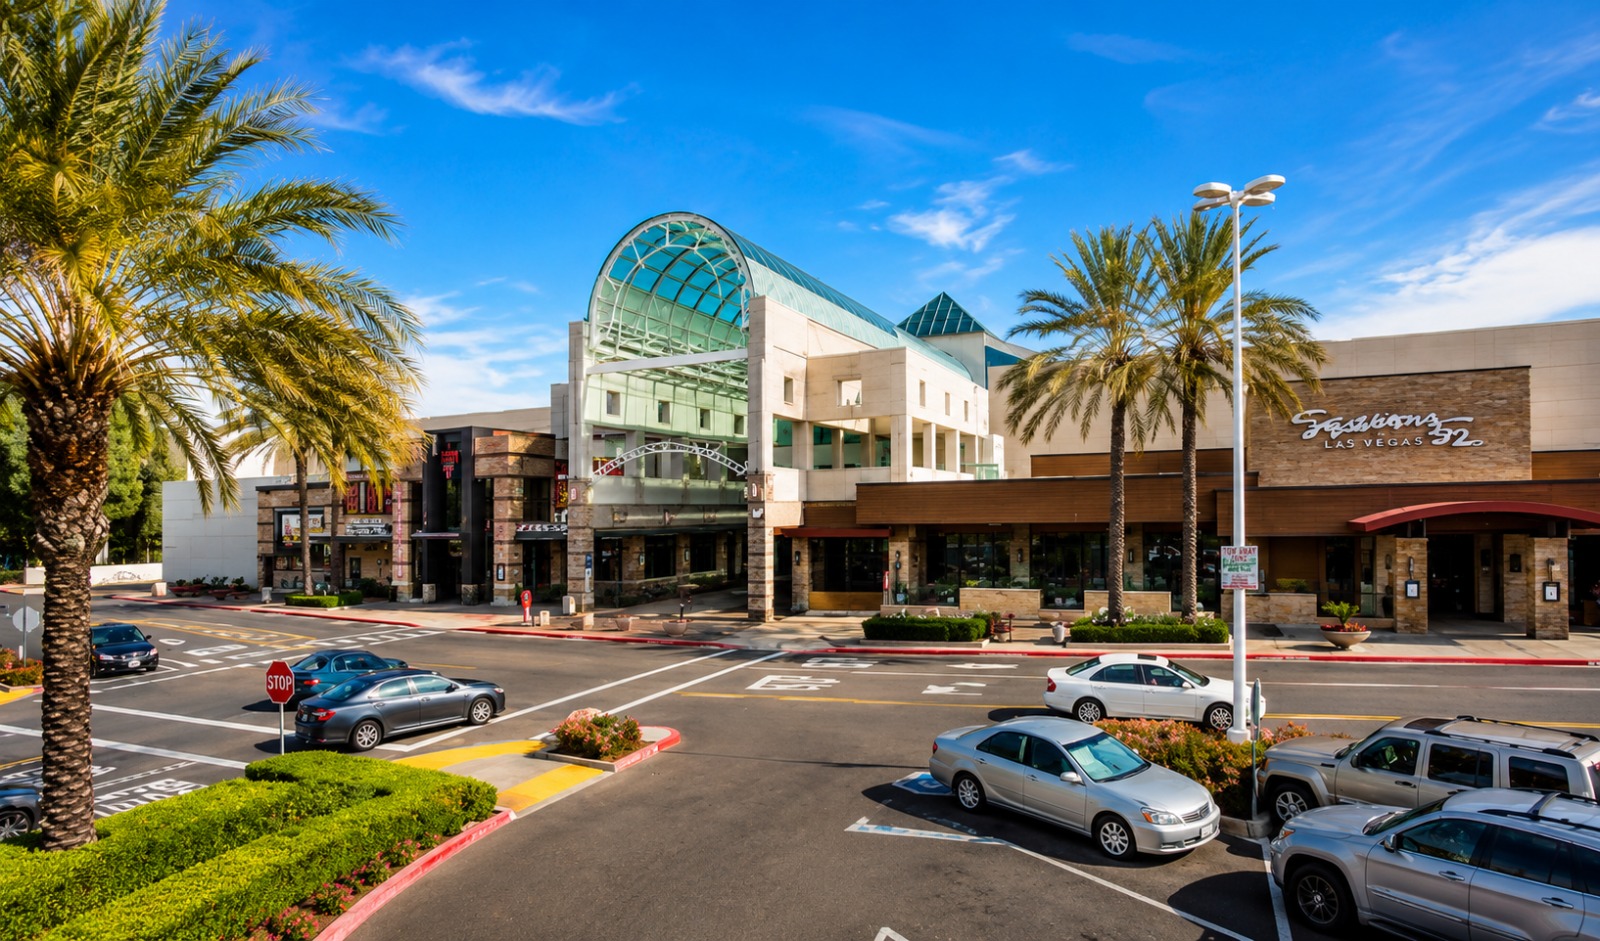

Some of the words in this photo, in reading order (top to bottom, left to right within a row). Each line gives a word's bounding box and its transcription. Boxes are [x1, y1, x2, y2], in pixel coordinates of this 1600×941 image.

[1324, 440, 1355, 449] LAS
[1364, 437, 1423, 447] VEGAS
[267, 675, 292, 691] STOP
